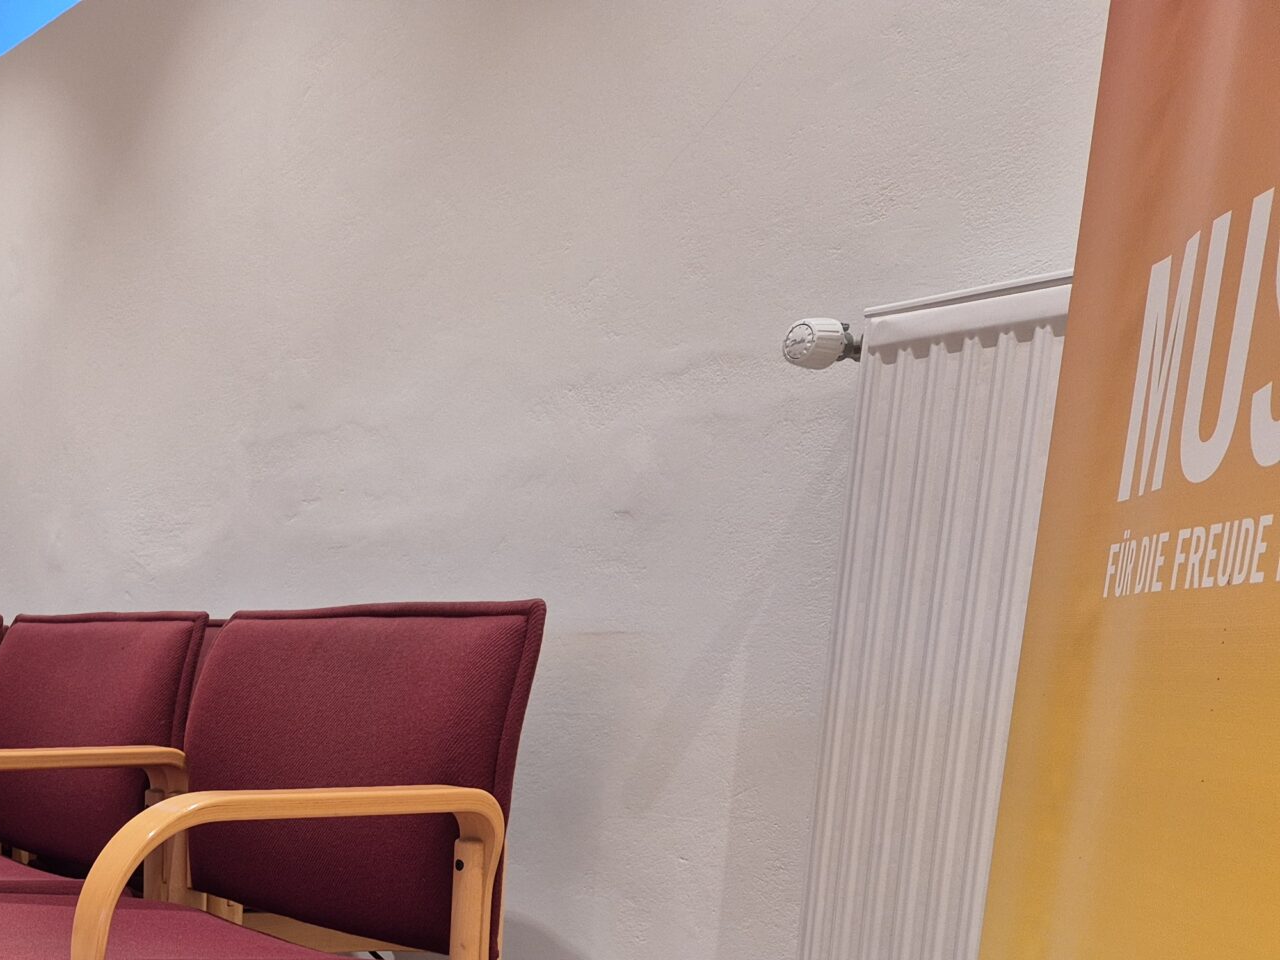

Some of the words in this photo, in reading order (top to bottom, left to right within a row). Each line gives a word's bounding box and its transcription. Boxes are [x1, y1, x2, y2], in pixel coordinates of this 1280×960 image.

[1103, 529, 1137, 598] FÜR
[1134, 532, 1170, 594] DIE
[1170, 514, 1274, 591] FREUDE
